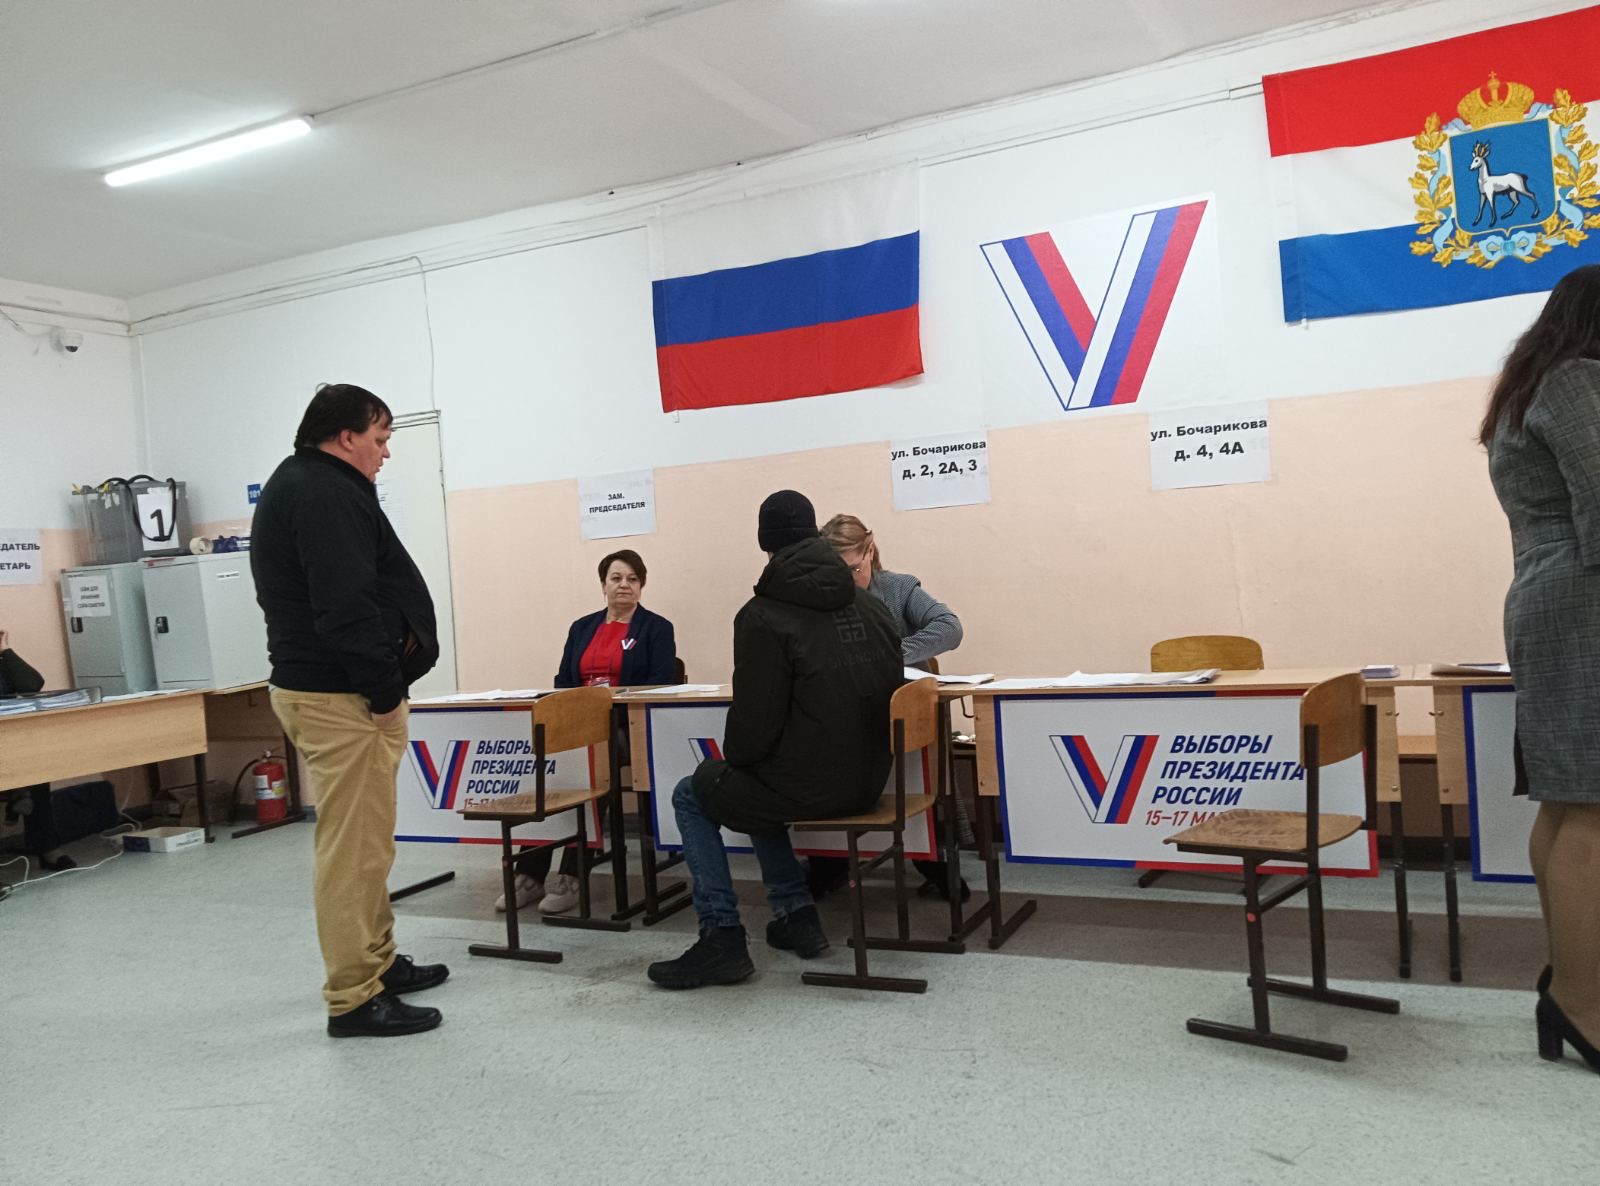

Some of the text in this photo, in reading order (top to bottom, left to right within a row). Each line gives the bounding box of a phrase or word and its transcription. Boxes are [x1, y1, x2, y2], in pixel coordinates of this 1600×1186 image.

[1150, 420, 1267, 442] ул. Бочарикова
[891, 441, 986, 461] ул. Бочарикова
[1174, 441, 1245, 462] д. 4, 4А
[902, 459, 978, 481] д. 2, 2А, 3
[589, 501, 646, 514] ПРЕДСЕДАТЕЛЯ
[0, 543, 41, 552] ДАТЕЛЬ
[1170, 735, 1273, 754] ВЫБОРЫ
[1160, 761, 1305, 783] ПРЕЗИДЕНТА
[465, 779, 521, 794] РОССИИ
[1151, 786, 1244, 806] РОССИИ
